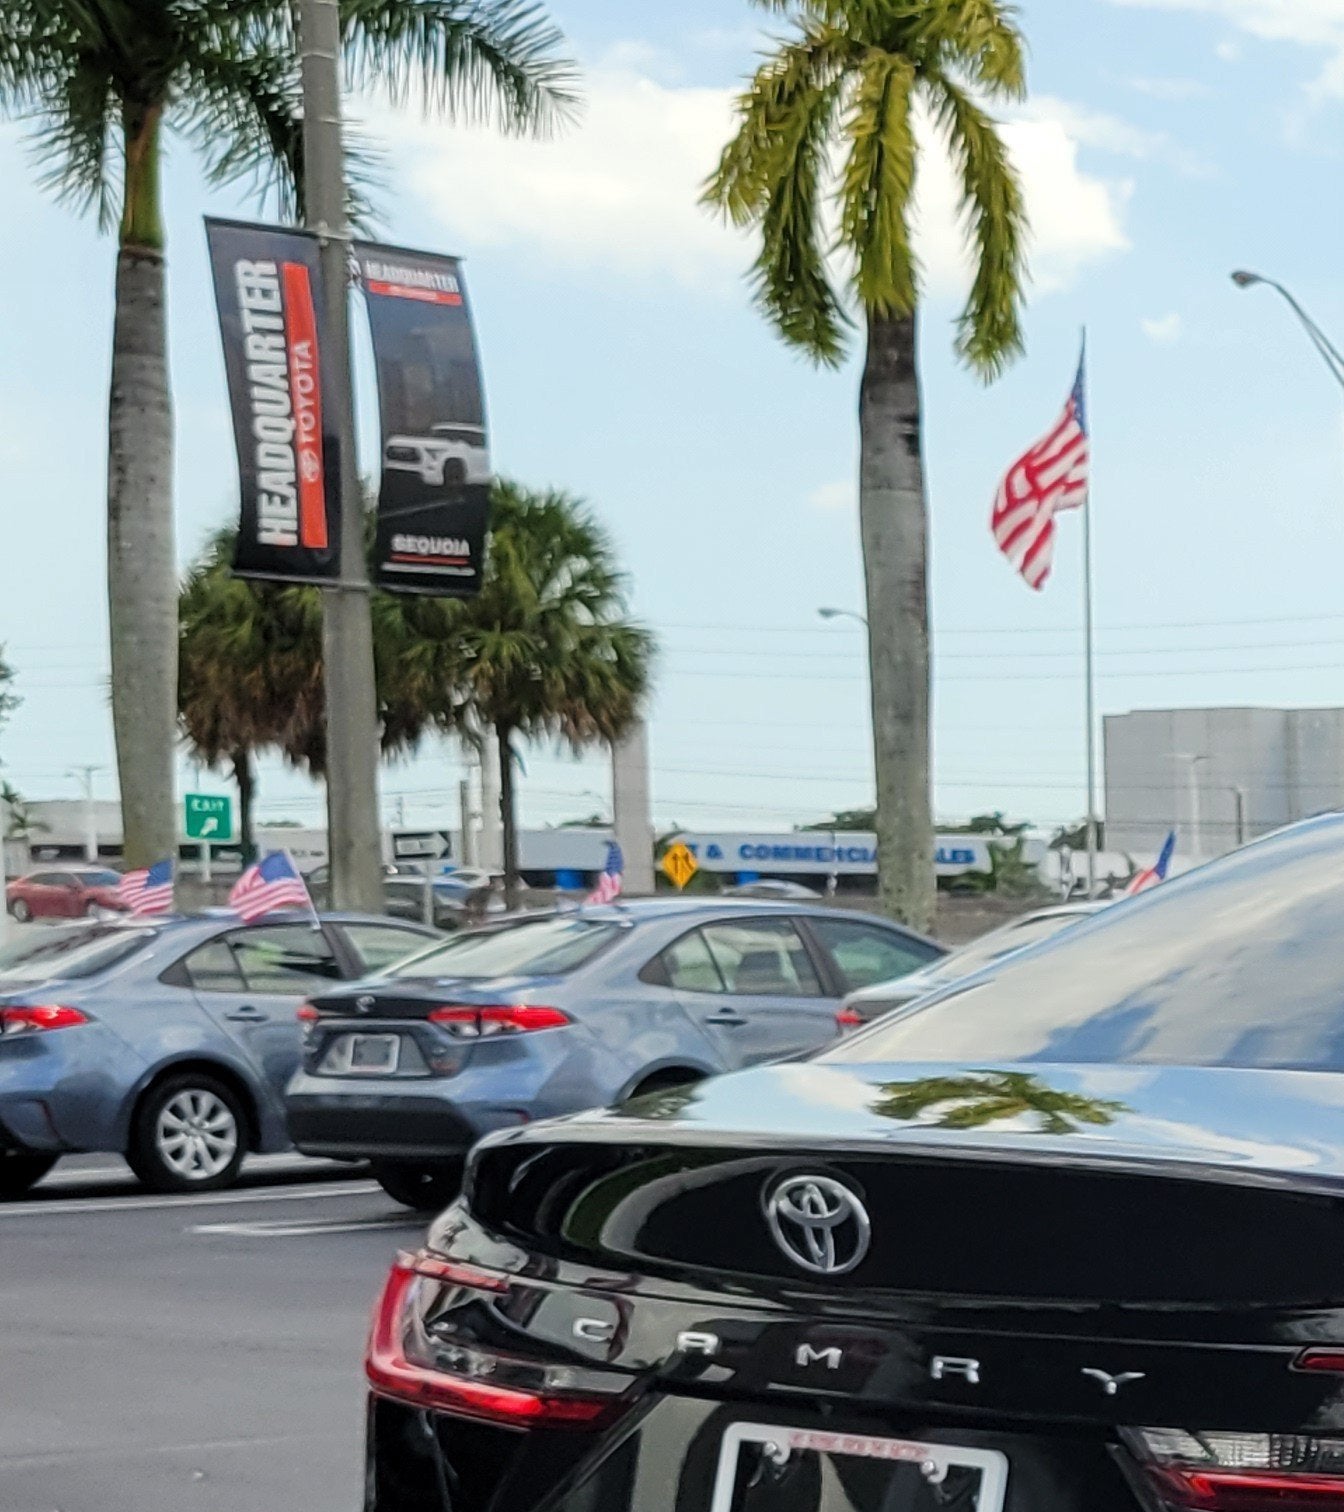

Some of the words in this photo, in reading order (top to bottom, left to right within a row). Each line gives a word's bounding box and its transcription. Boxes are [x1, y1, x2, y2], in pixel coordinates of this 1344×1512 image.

[235, 259, 298, 546] HEADQUARTER
[294, 340, 316, 442] TOYOTA
[391, 533, 470, 557] SEQUOIA
[572, 1317, 1146, 1395] CAMRY
